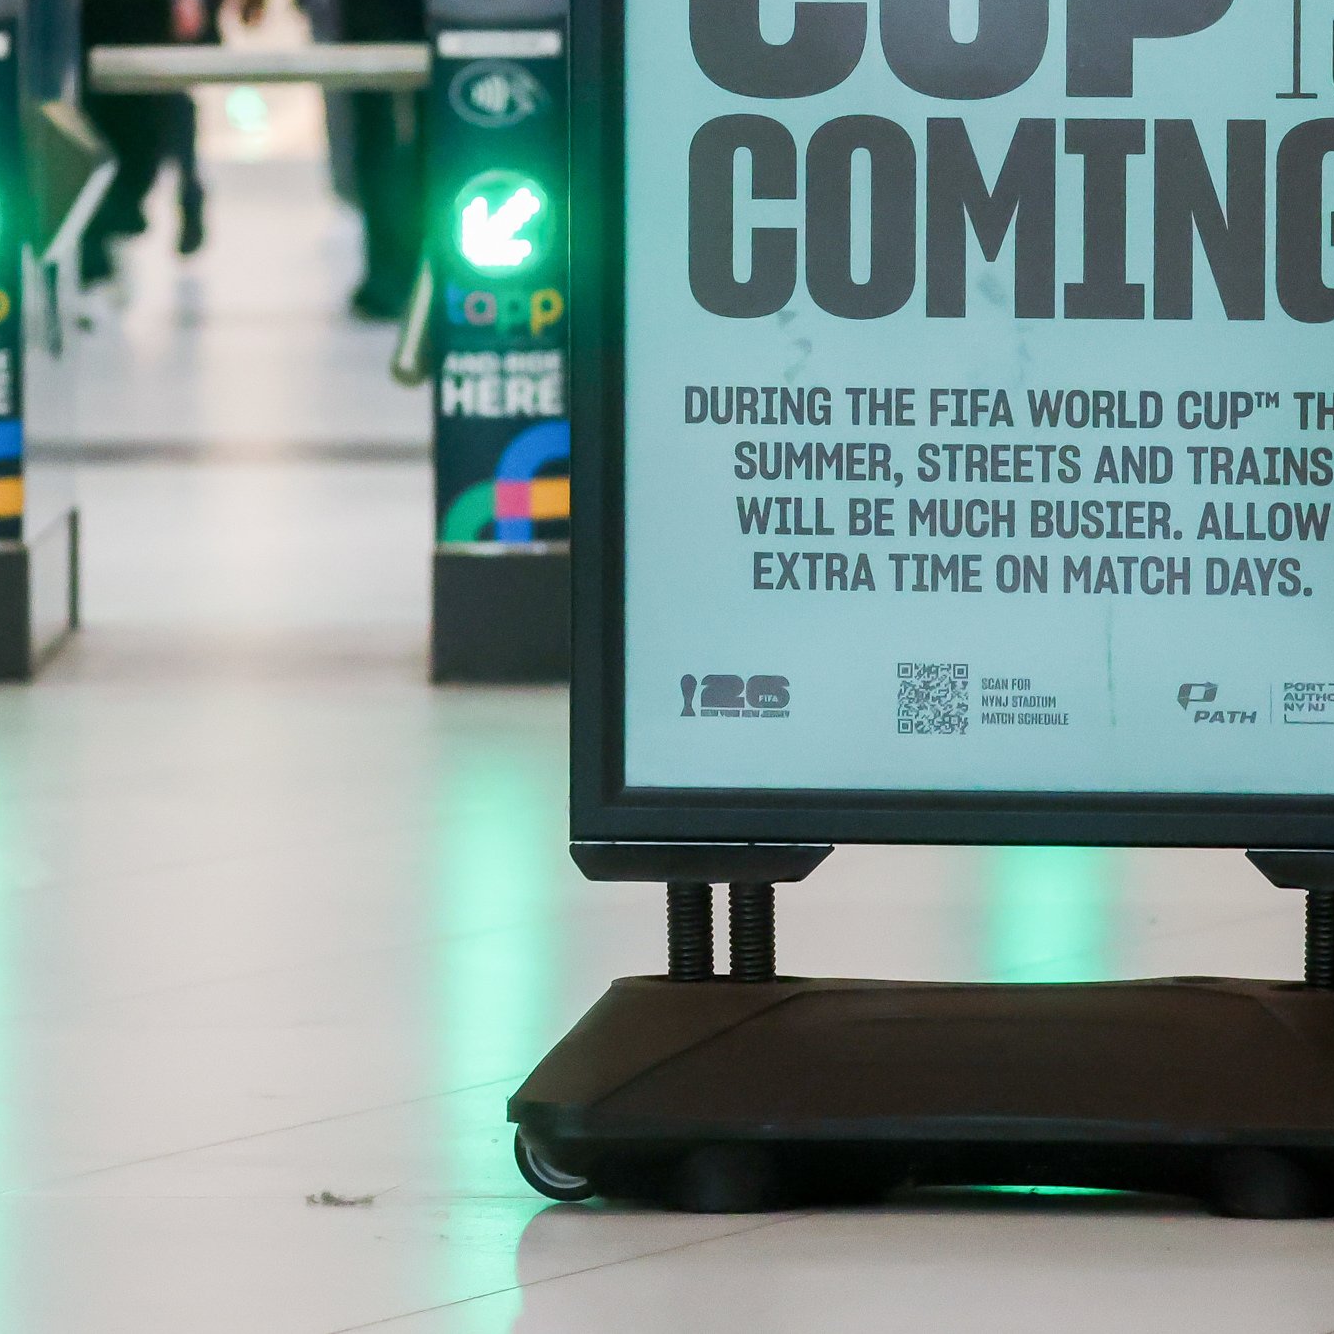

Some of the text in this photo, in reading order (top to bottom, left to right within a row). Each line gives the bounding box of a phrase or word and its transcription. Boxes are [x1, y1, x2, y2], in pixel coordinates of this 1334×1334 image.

[445, 282, 564, 338] tapp
[441, 373, 564, 417] HERE
[685, 386, 831, 425] DURING
[845, 388, 915, 426] THE
[930, 389, 1014, 427] FIFA
[1027, 390, 1163, 428] WORLD
[734, 441, 1333, 487] SUMMER, STREETS AND TRAINS
[736, 497, 1331, 541] WILL BE MUCH BUSIER. ALLOW
[754, 552, 1312, 596] EXTRA TIME ON MATCH DAYS.
[981, 678, 1031, 691] SCAN FOR
[981, 696, 1057, 709] NYNJ STADIUM
[1284, 682, 1325, 692] PORT
[981, 713, 1069, 726] MATCH SCHEDULE
[1194, 711, 1257, 724] PATH
